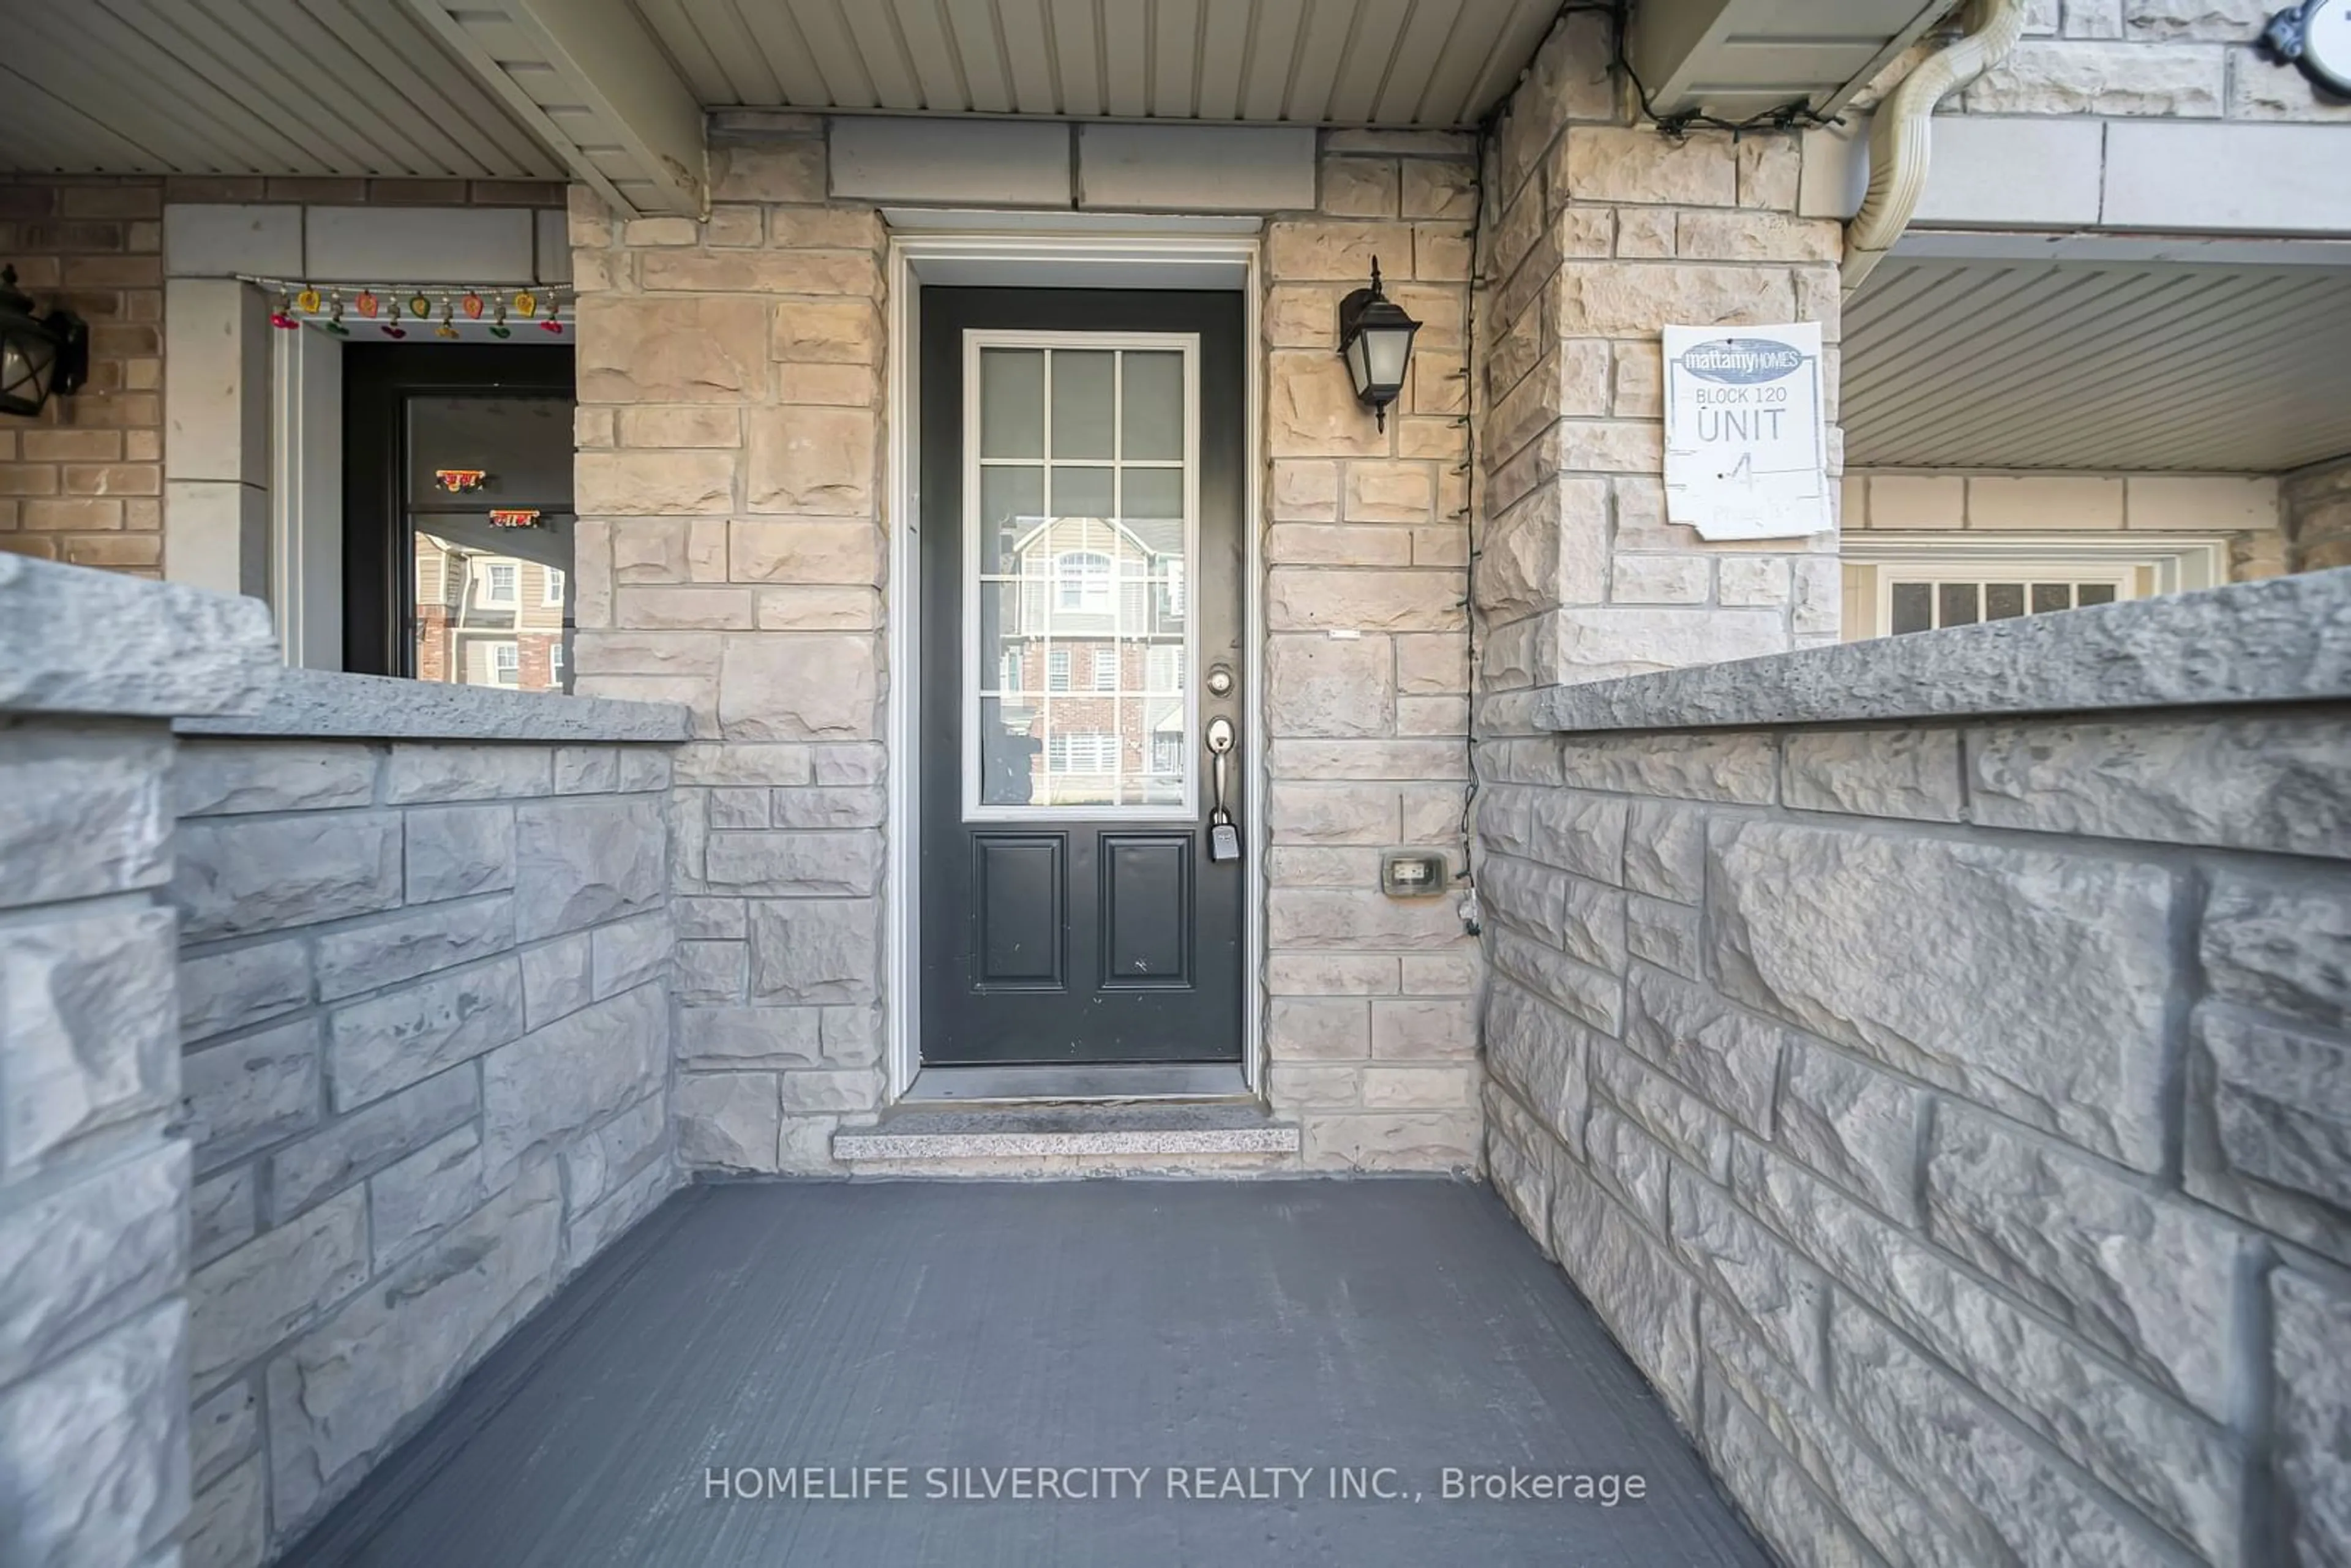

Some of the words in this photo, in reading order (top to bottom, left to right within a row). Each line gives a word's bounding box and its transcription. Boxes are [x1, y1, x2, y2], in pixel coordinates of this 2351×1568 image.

[1696, 388, 1748, 403] BLOCK
[1755, 387, 1787, 402] 120
[1698, 408, 1786, 442] UNIT
